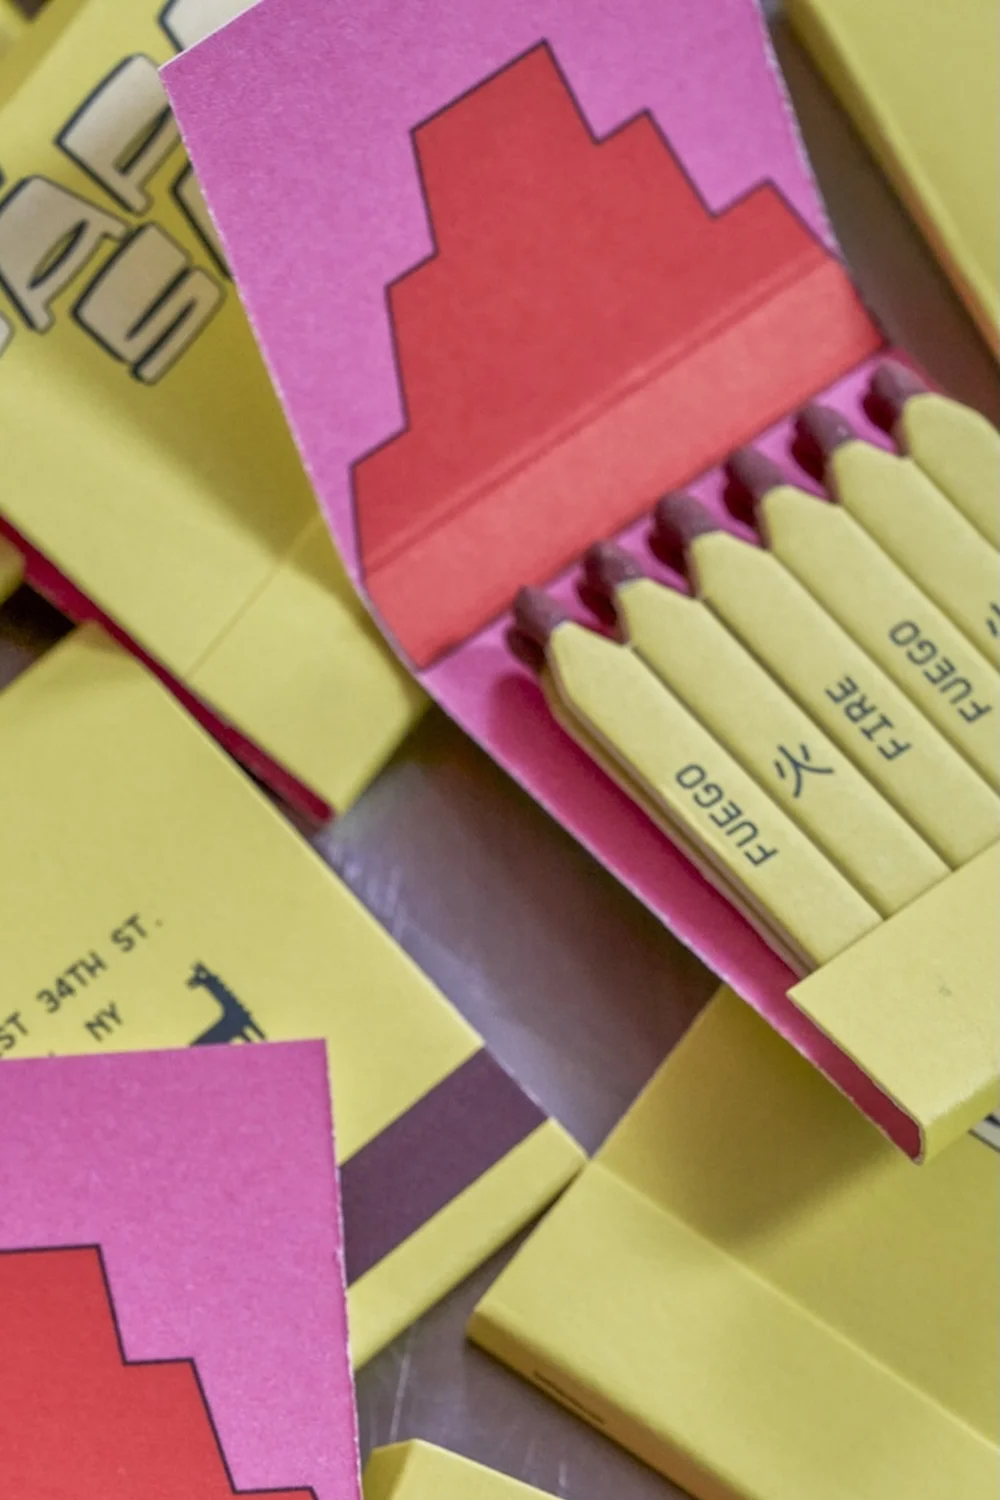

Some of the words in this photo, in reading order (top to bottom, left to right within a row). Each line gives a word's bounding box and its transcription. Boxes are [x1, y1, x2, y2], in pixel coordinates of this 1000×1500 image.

[824, 673, 913, 762] FIRE
[888, 619, 993, 724] FUEGO
[675, 762, 780, 868] FUEGO
[773, 742, 836, 798] 火
[36, 949, 108, 1014] 34TH
[111, 912, 163, 953] ST.
[84, 1000, 124, 1042] NY
